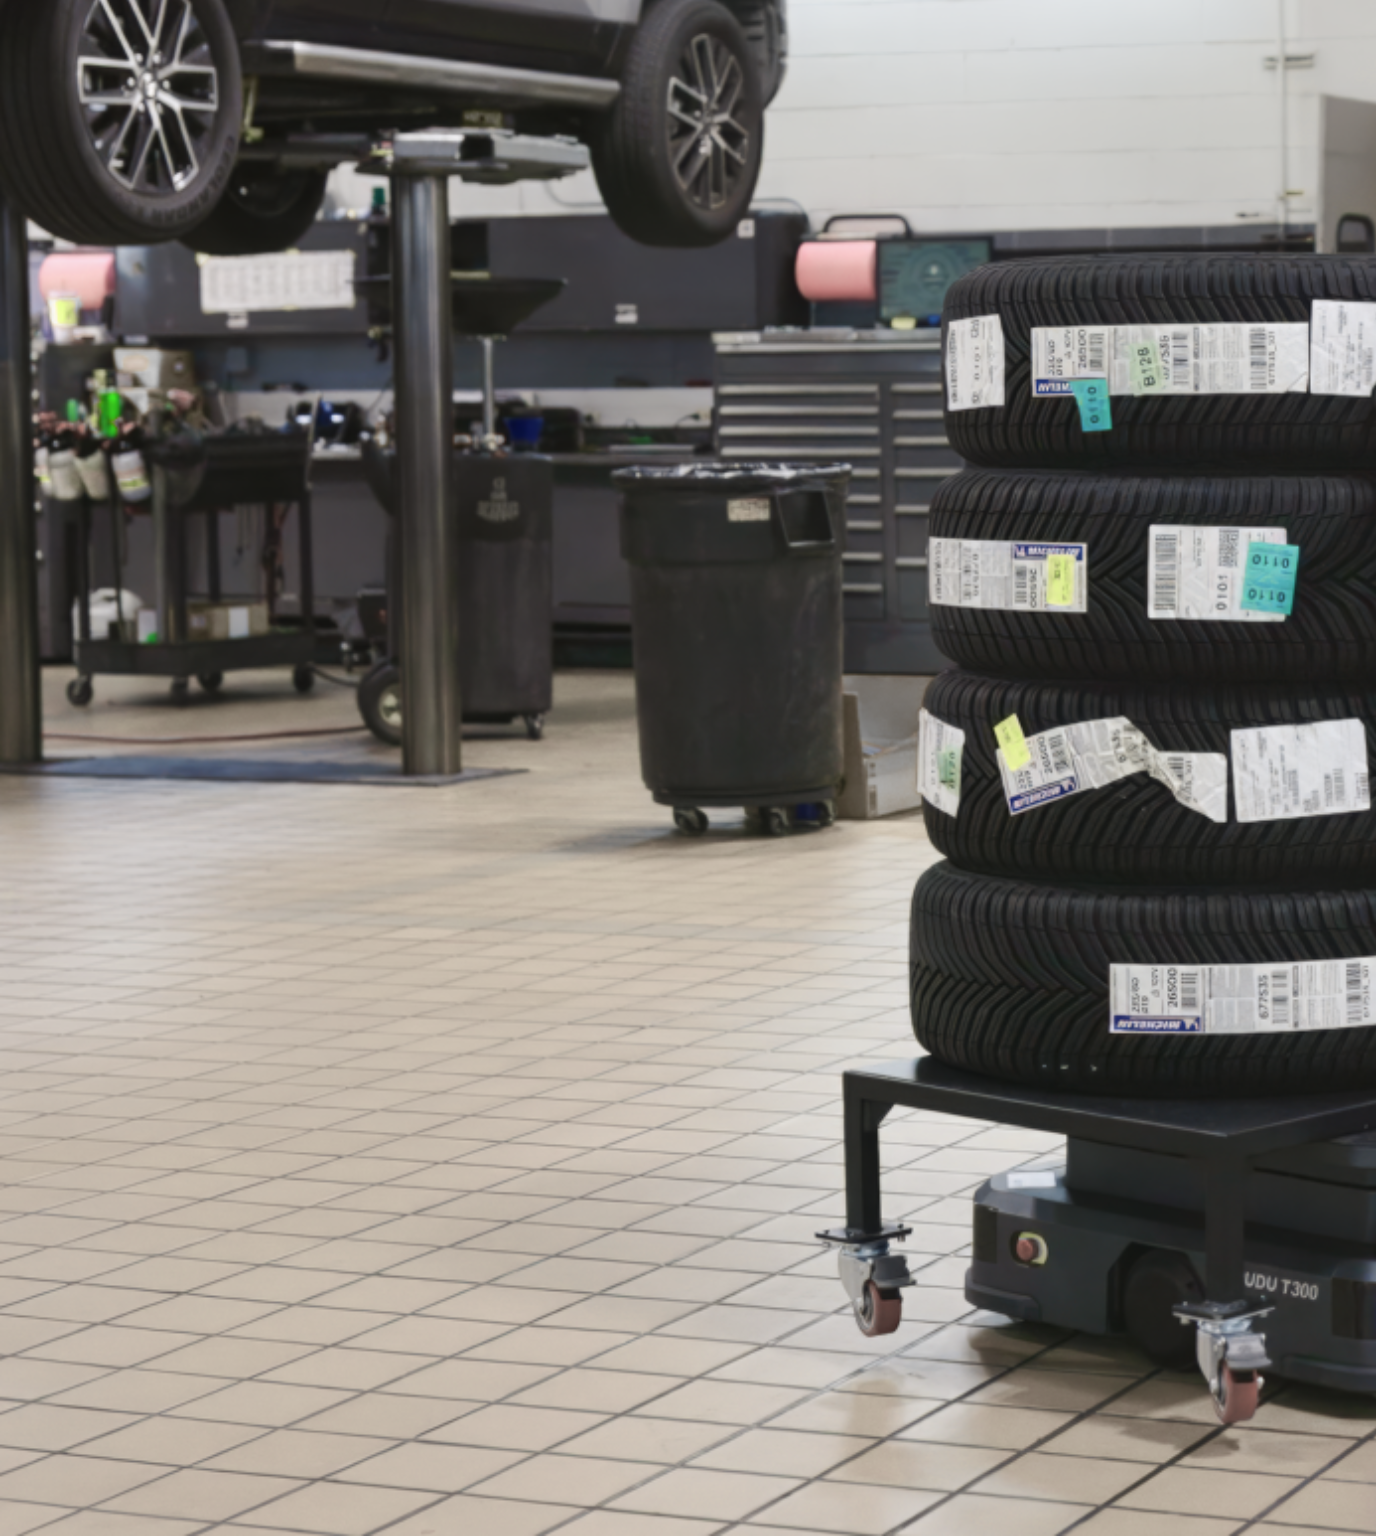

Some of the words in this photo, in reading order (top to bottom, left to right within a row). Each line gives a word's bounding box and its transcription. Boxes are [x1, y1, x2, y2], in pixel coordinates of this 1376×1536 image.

[1087, 386, 1100, 424] 0110
[1252, 554, 1290, 569] 0110
[1215, 574, 1228, 610] 0101
[1248, 588, 1286, 603] 0110
[1167, 967, 1178, 1008] 26500
[1259, 975, 1269, 1019] 677535
[1244, 1271, 1278, 1292] UDU
[1281, 1279, 1319, 1300] T300
